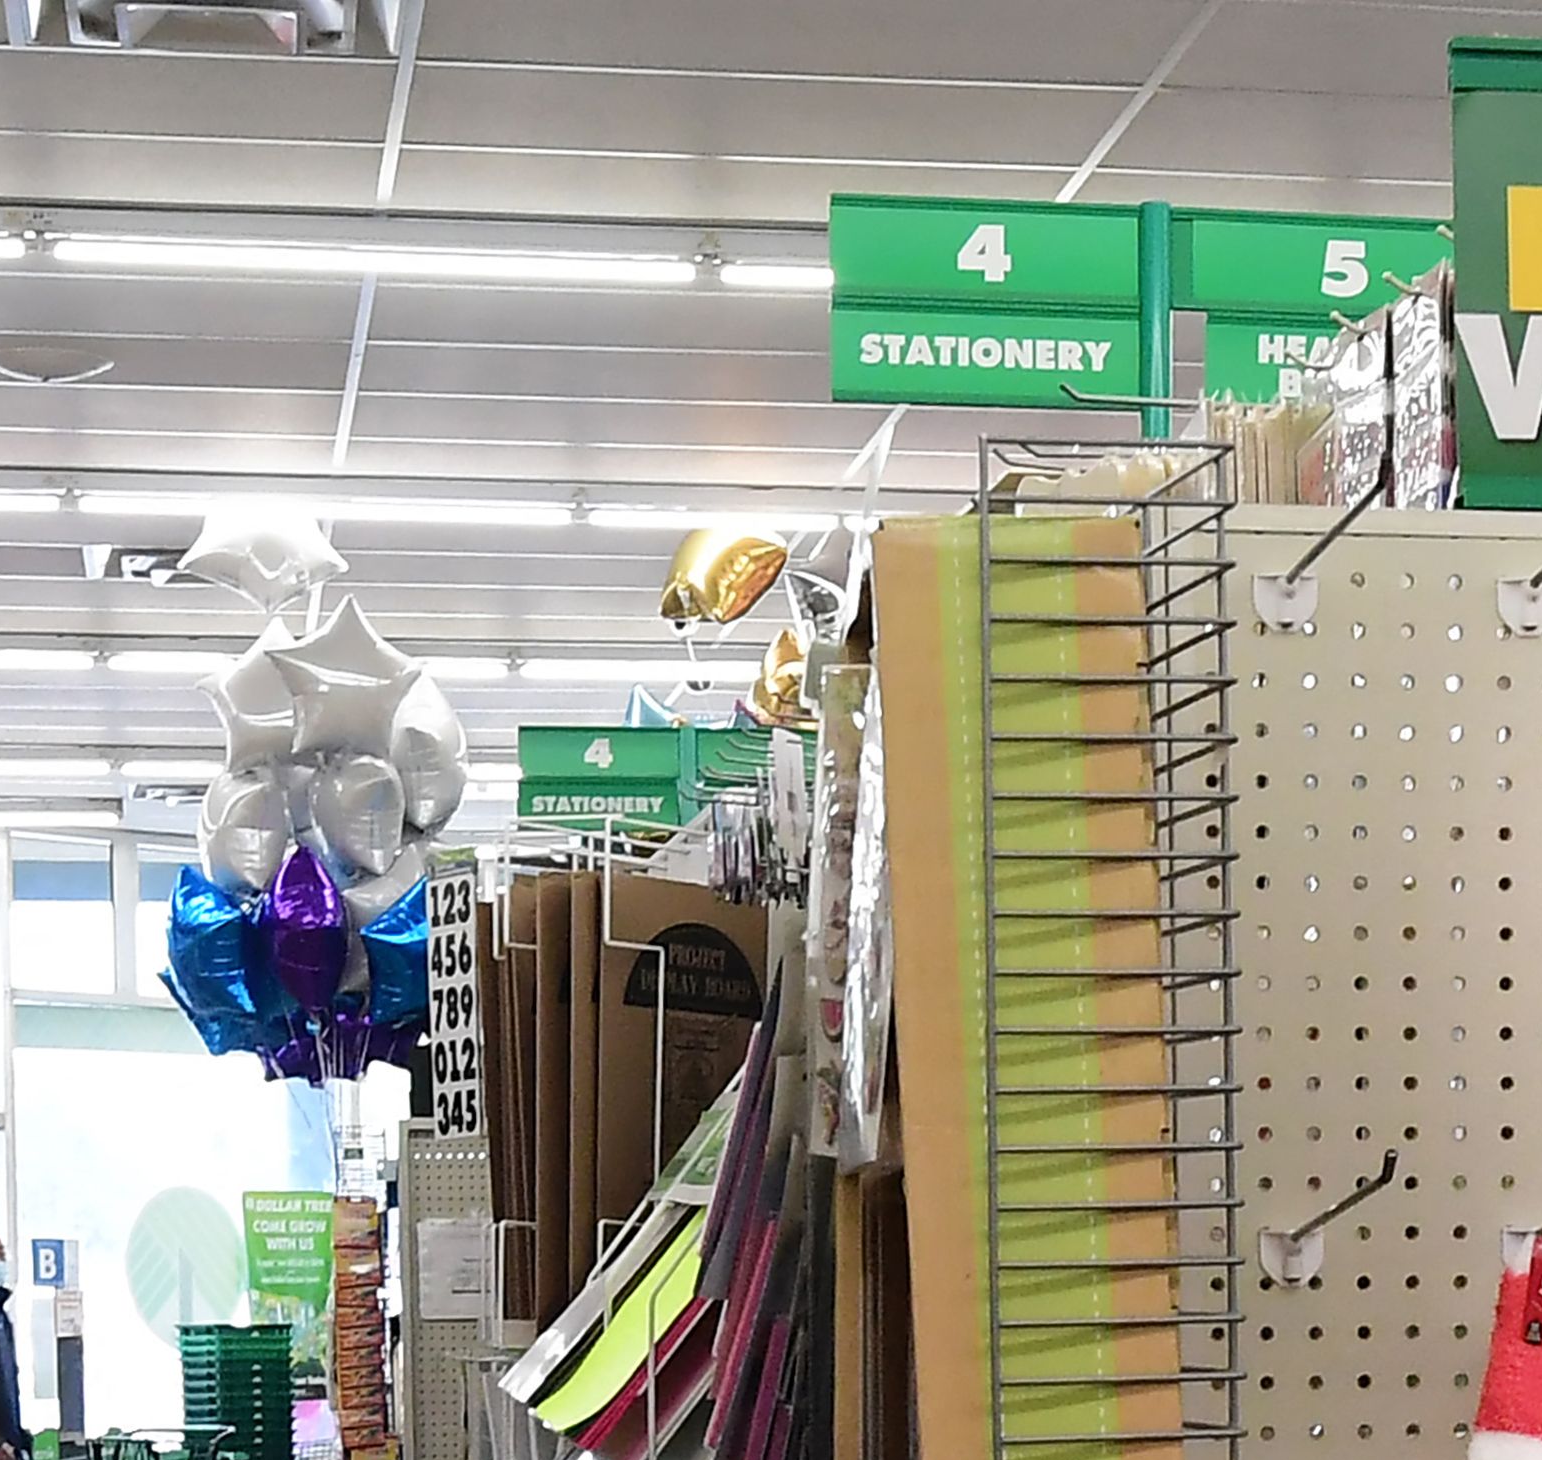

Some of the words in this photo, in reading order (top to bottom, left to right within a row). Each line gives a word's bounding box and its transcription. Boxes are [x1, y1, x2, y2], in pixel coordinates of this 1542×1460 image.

[957, 225, 1012, 283] 4
[1320, 240, 1368, 297] 5
[860, 333, 1112, 373] STATIONERY
[1257, 333, 1331, 364] HEA
[583, 737, 613, 768] 4
[532, 794, 664, 815] STATIONERY
[429, 879, 471, 926] 123
[431, 932, 473, 977] 456
[433, 987, 474, 1032] 789
[434, 1041, 476, 1083] 012
[437, 1095, 477, 1136] 345
[256, 1199, 302, 1212] DOLLAR
[253, 1220, 286, 1233] COME
[288, 1220, 327, 1233] GROW
[265, 1237, 296, 1250] WITH
[298, 1237, 314, 1250] US
[38, 1249, 57, 1277] B
